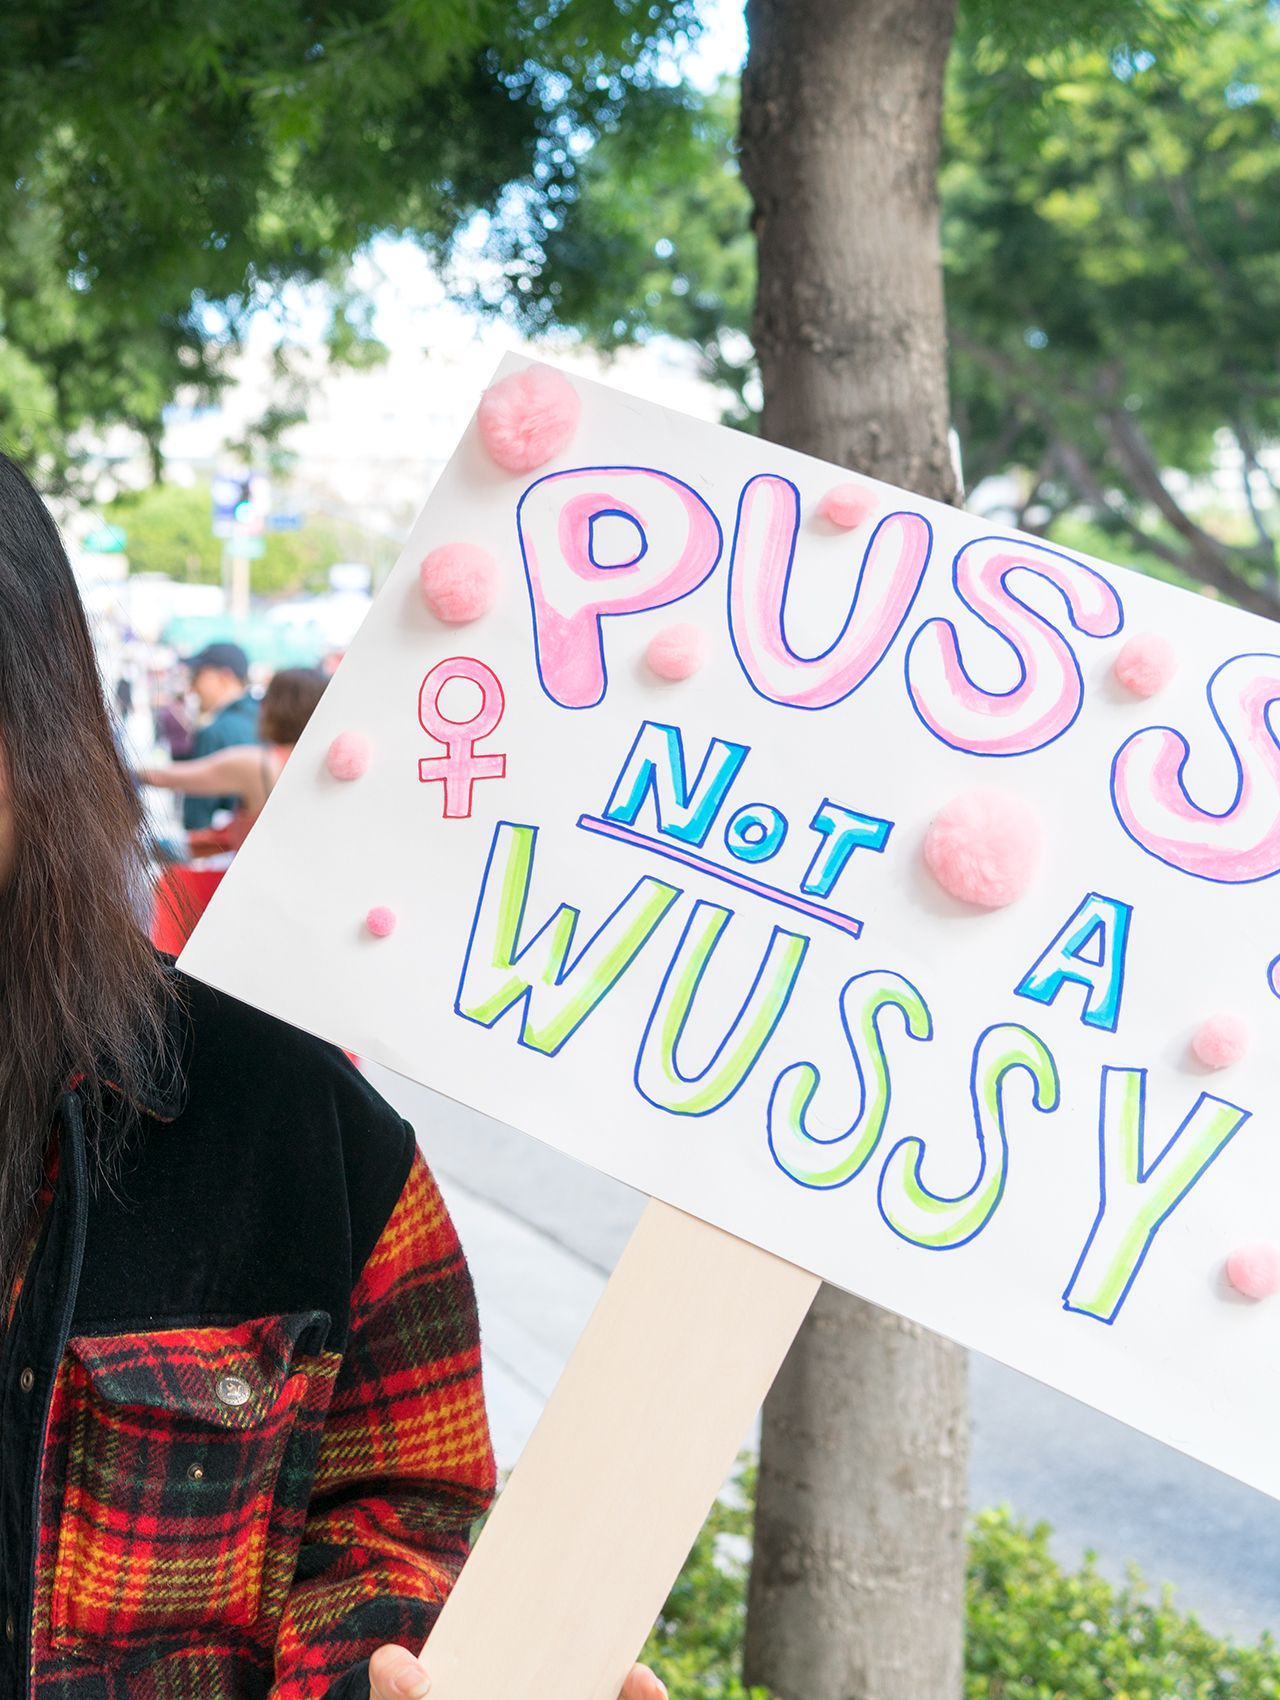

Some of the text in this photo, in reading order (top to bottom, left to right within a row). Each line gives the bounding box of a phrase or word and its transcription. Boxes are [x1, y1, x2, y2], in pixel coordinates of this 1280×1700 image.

[516, 465, 1280, 999] PUSS
[1013, 891, 1134, 1033] A
[453, 820, 1253, 1326] WUSSY
